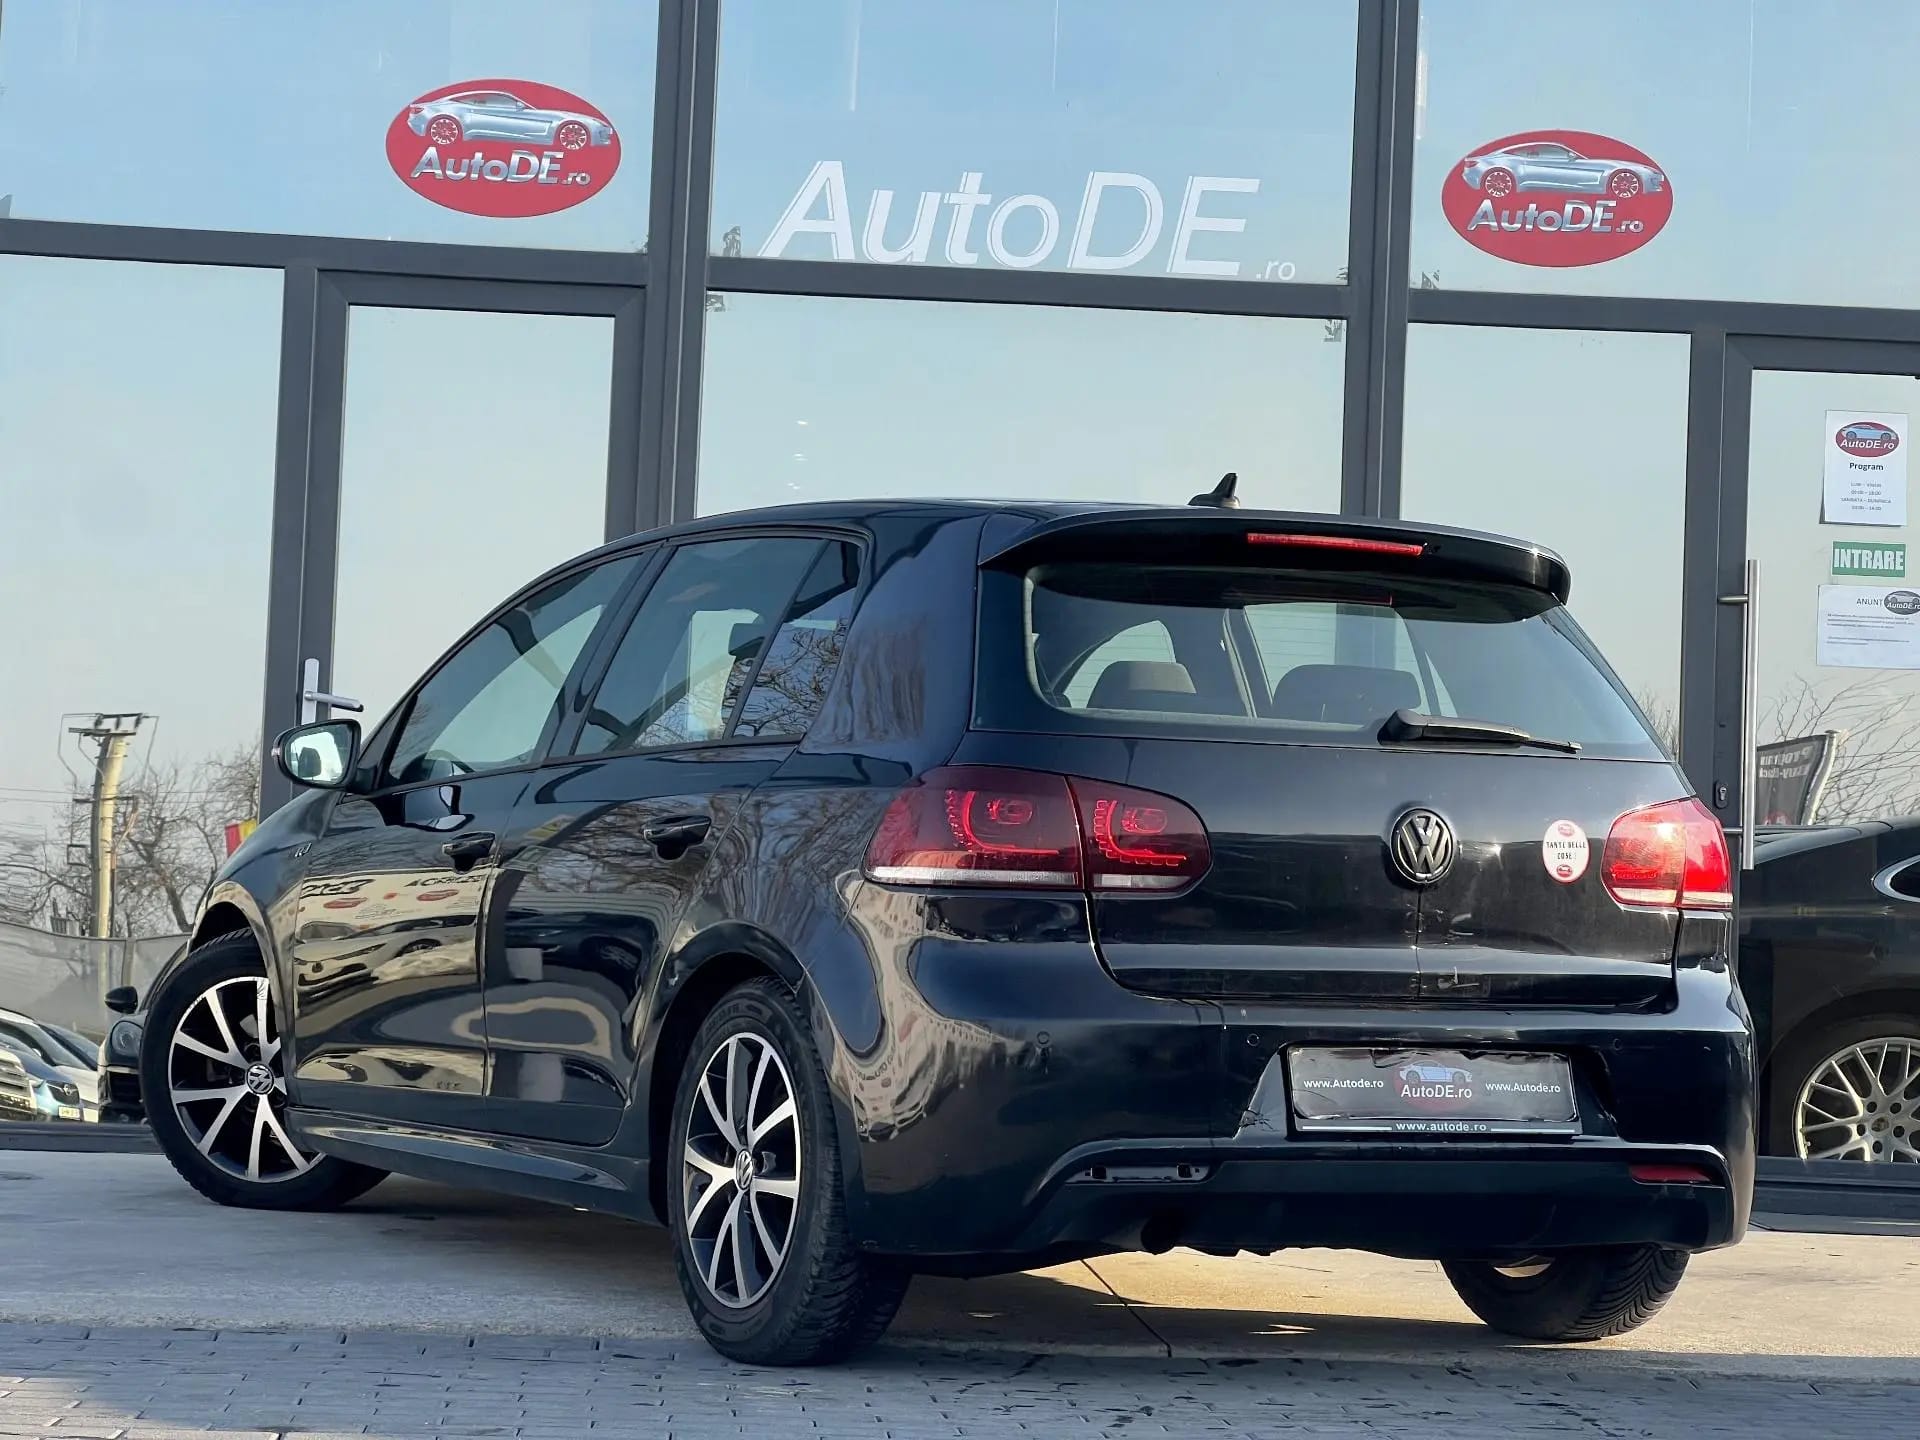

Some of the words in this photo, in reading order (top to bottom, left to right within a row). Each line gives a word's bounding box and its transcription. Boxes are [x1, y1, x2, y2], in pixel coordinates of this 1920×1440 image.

[409, 146, 591, 186] AutoDE.ro
[1466, 198, 1645, 234] AutoDE.ro
[1840, 439, 1895, 450] AutoDE.ro
[1849, 462, 1884, 472] Program
[1833, 548, 1904, 571] INTRARE
[1303, 1078, 1384, 1088] www.Autode.ro
[1401, 1085, 1472, 1098] AutoDE.ro
[1485, 1082, 1561, 1093] www.Autode.ro
[1396, 1121, 1487, 1132] www.autode.ro
